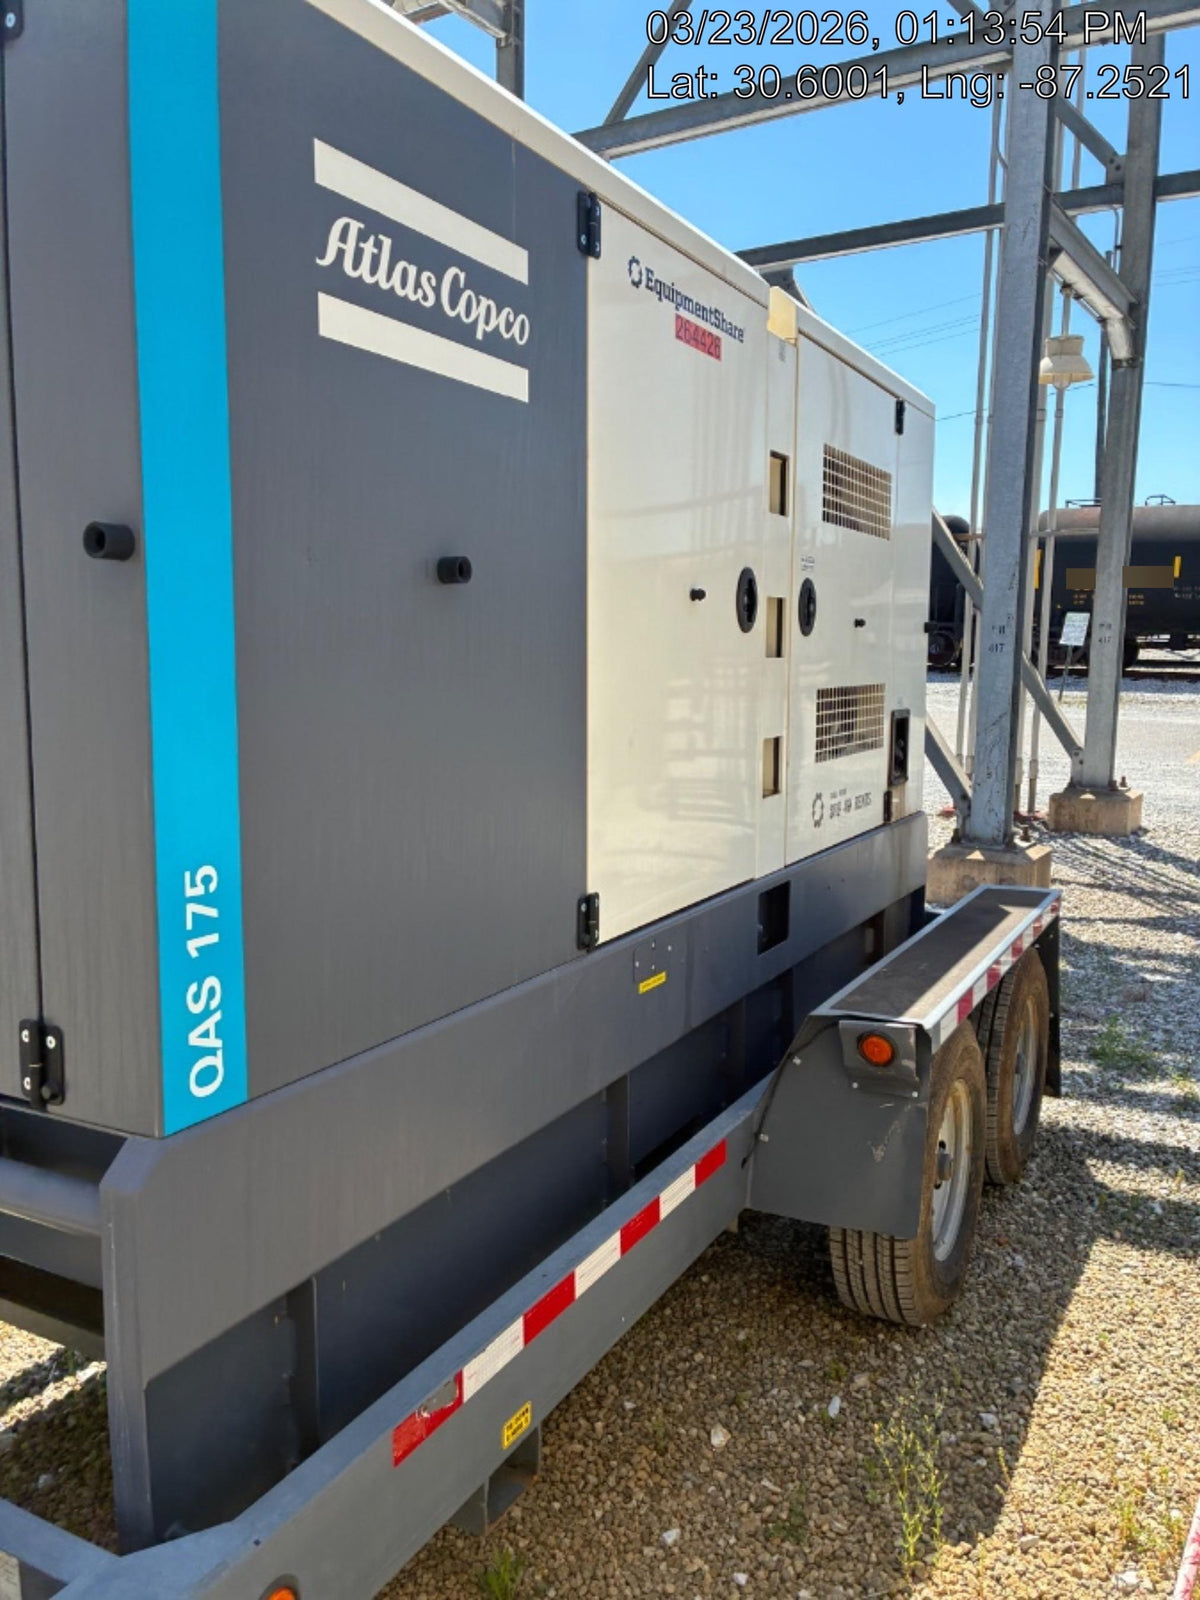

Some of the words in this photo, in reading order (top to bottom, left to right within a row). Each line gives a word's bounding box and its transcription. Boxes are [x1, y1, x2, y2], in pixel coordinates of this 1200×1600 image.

[316, 216, 437, 308] Atlas
[440, 266, 530, 345] Copco
[644, 266, 744, 344] EquipmentShare
[675, 313, 722, 361] 264426
[184, 864, 219, 959] 175
[186, 975, 224, 1098] QAS
